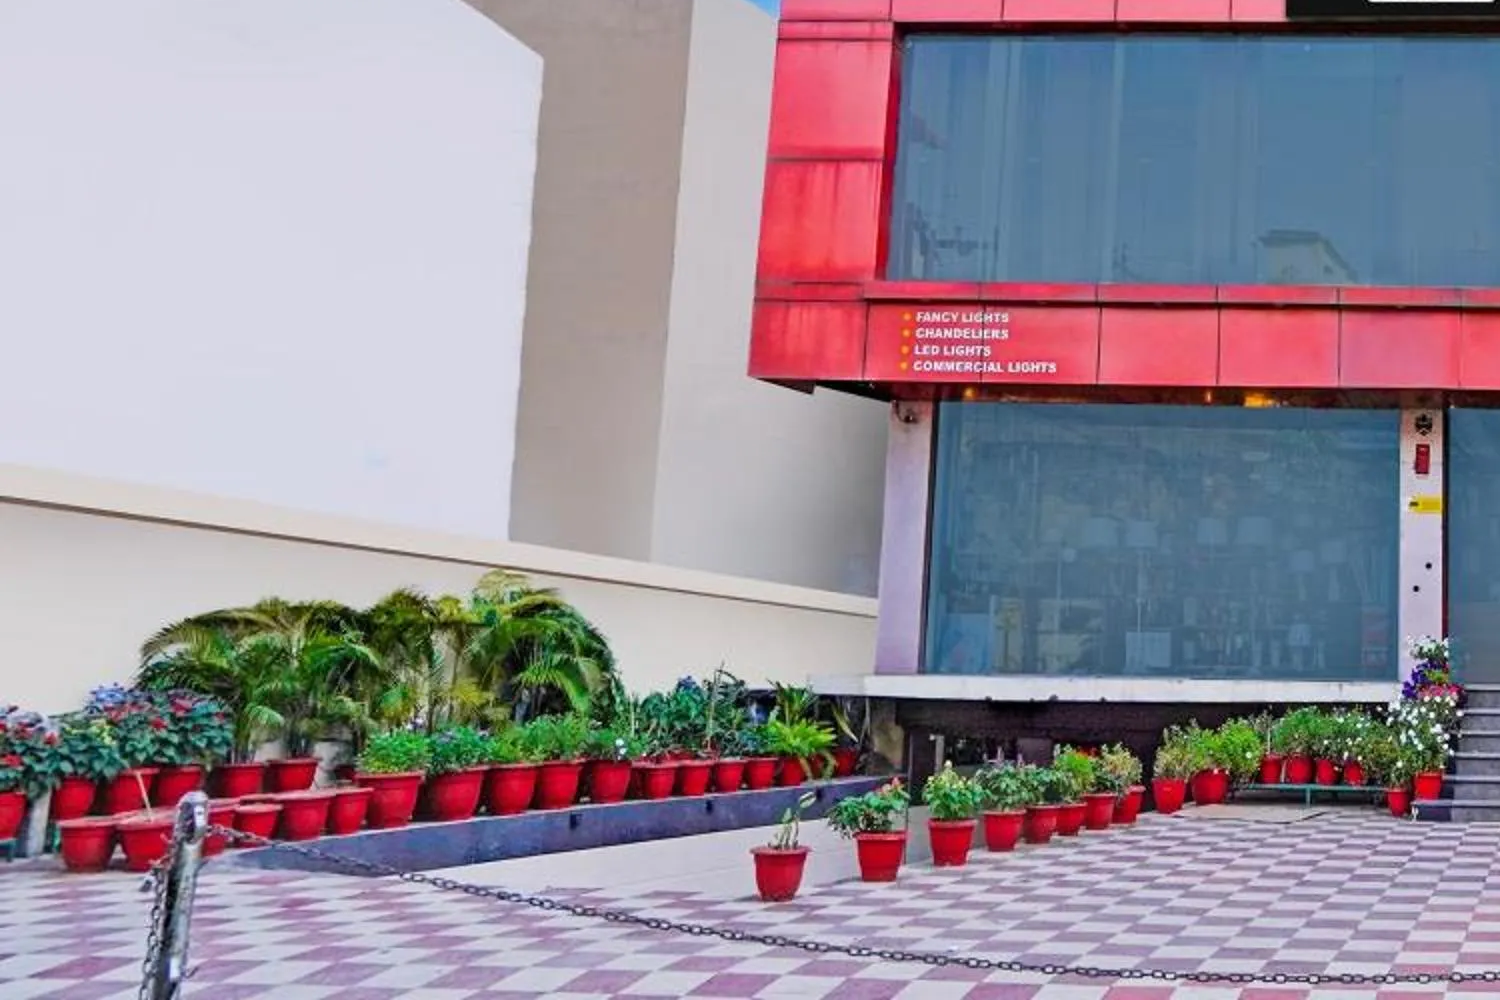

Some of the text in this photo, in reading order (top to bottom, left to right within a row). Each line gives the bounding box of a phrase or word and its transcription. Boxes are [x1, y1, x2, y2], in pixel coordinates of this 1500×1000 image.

[915, 311, 1009, 323] FANCY LIGHTS
[915, 328, 1009, 339] CHANDELIERS
[914, 345, 992, 357] LED LIGHTS
[913, 361, 1057, 373] COMMERCIAL LIGHTS
